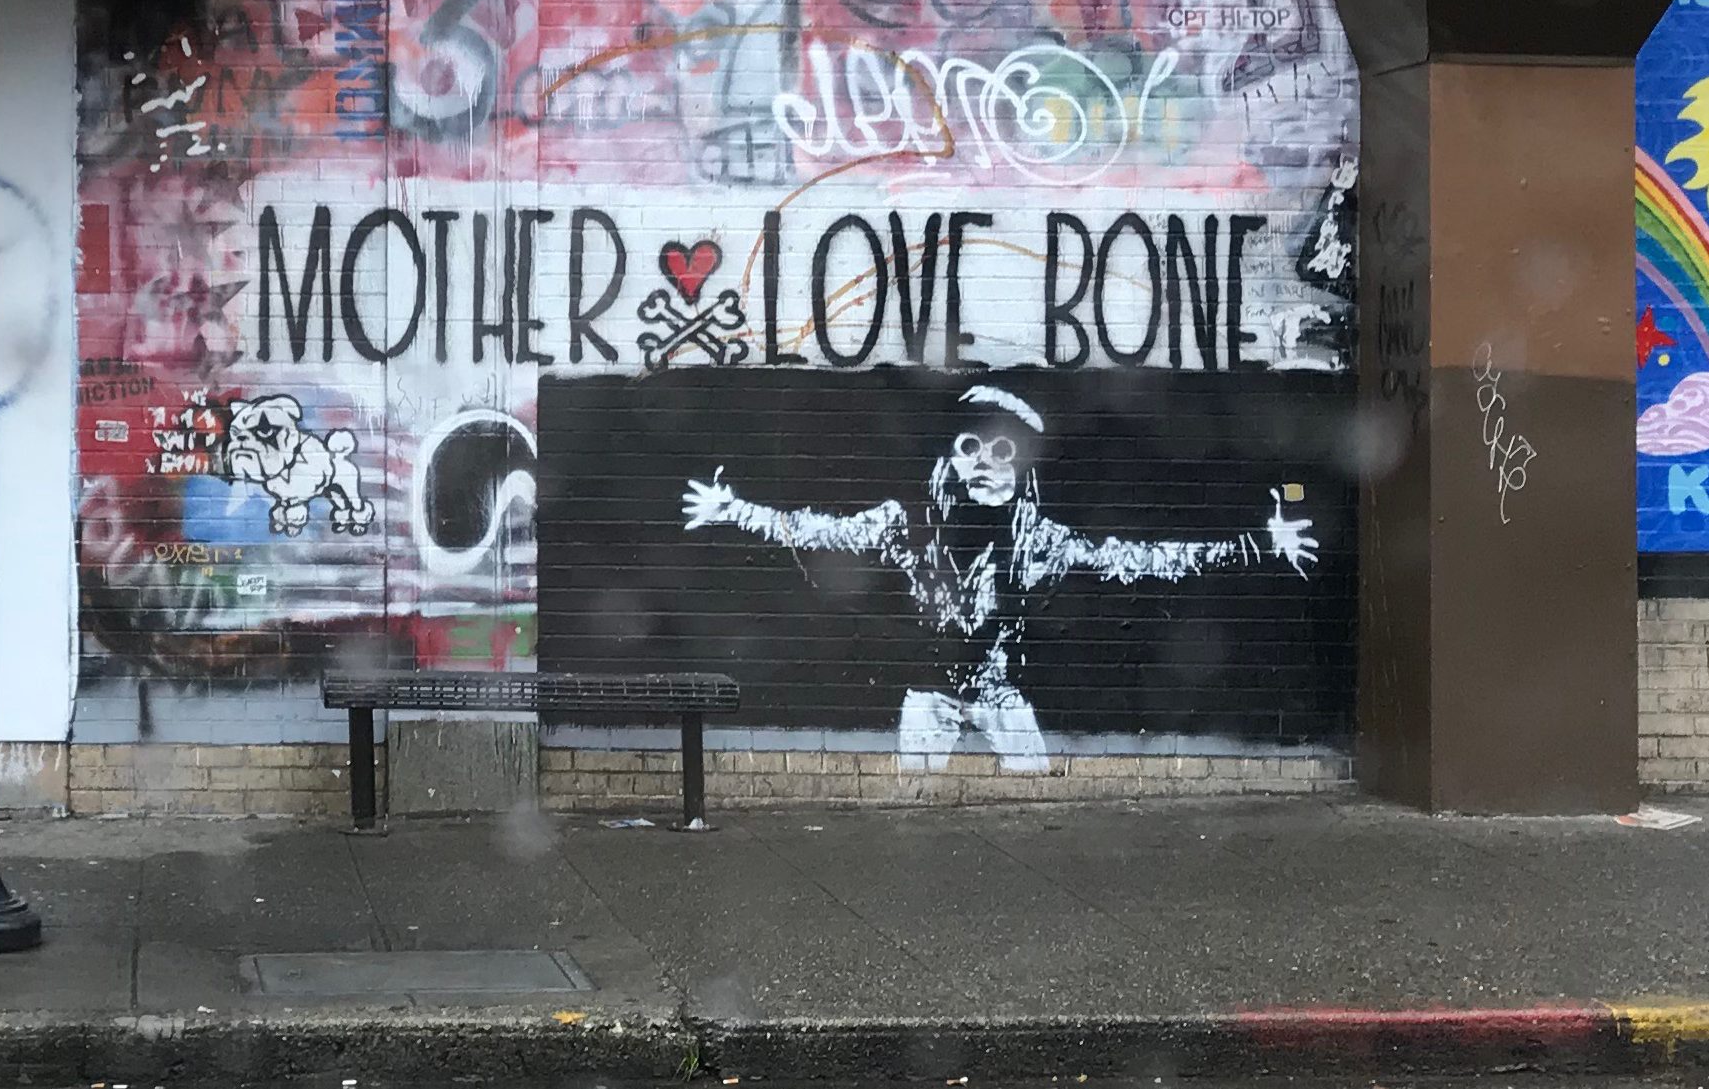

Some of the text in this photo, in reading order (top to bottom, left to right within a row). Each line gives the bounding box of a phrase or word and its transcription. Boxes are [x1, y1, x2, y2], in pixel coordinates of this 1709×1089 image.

[1167, 8, 1291, 28] CPT HI-TOP
[256, 204, 627, 364] MOTHER
[762, 210, 994, 368] LOVE
[1044, 210, 1268, 371] BONE
